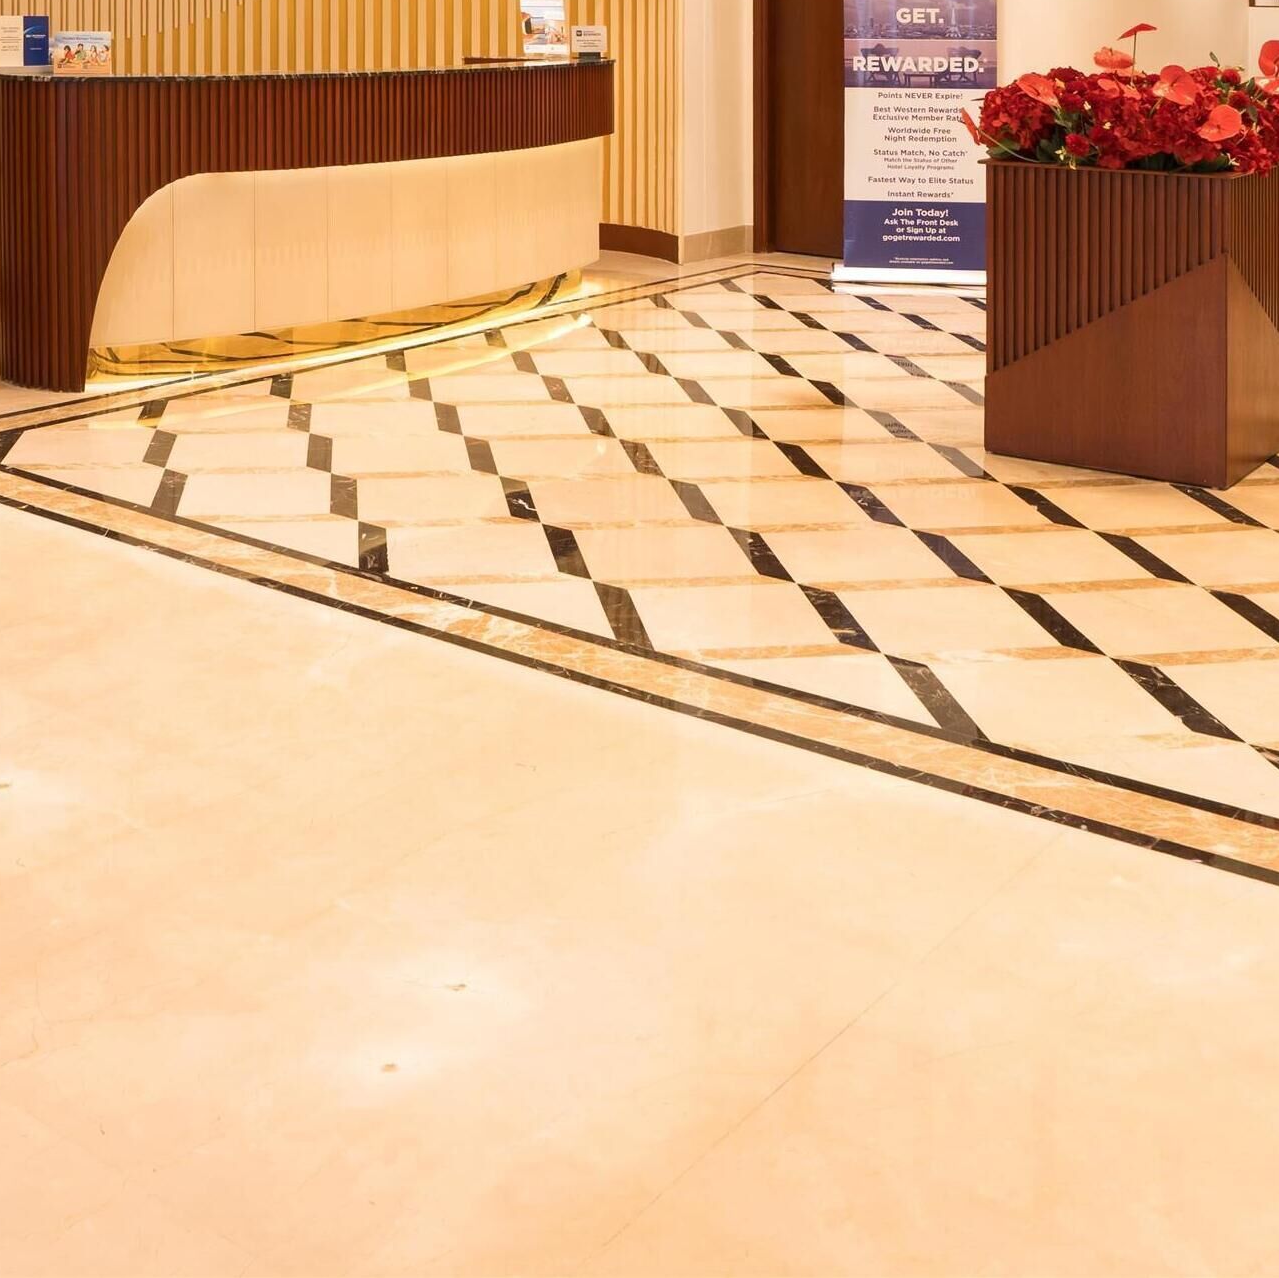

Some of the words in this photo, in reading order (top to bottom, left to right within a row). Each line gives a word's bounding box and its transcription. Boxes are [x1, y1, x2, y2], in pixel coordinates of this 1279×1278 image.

[896, 7, 944, 24] GET.
[884, 135, 906, 143] Night
[908, 135, 957, 143] Redemption
[900, 149, 927, 157] Match,
[898, 177, 916, 185] Way
[892, 208, 913, 216] Join
[915, 208, 949, 218] Today!
[906, 226, 924, 235] Sign
[925, 227, 937, 235] Up
